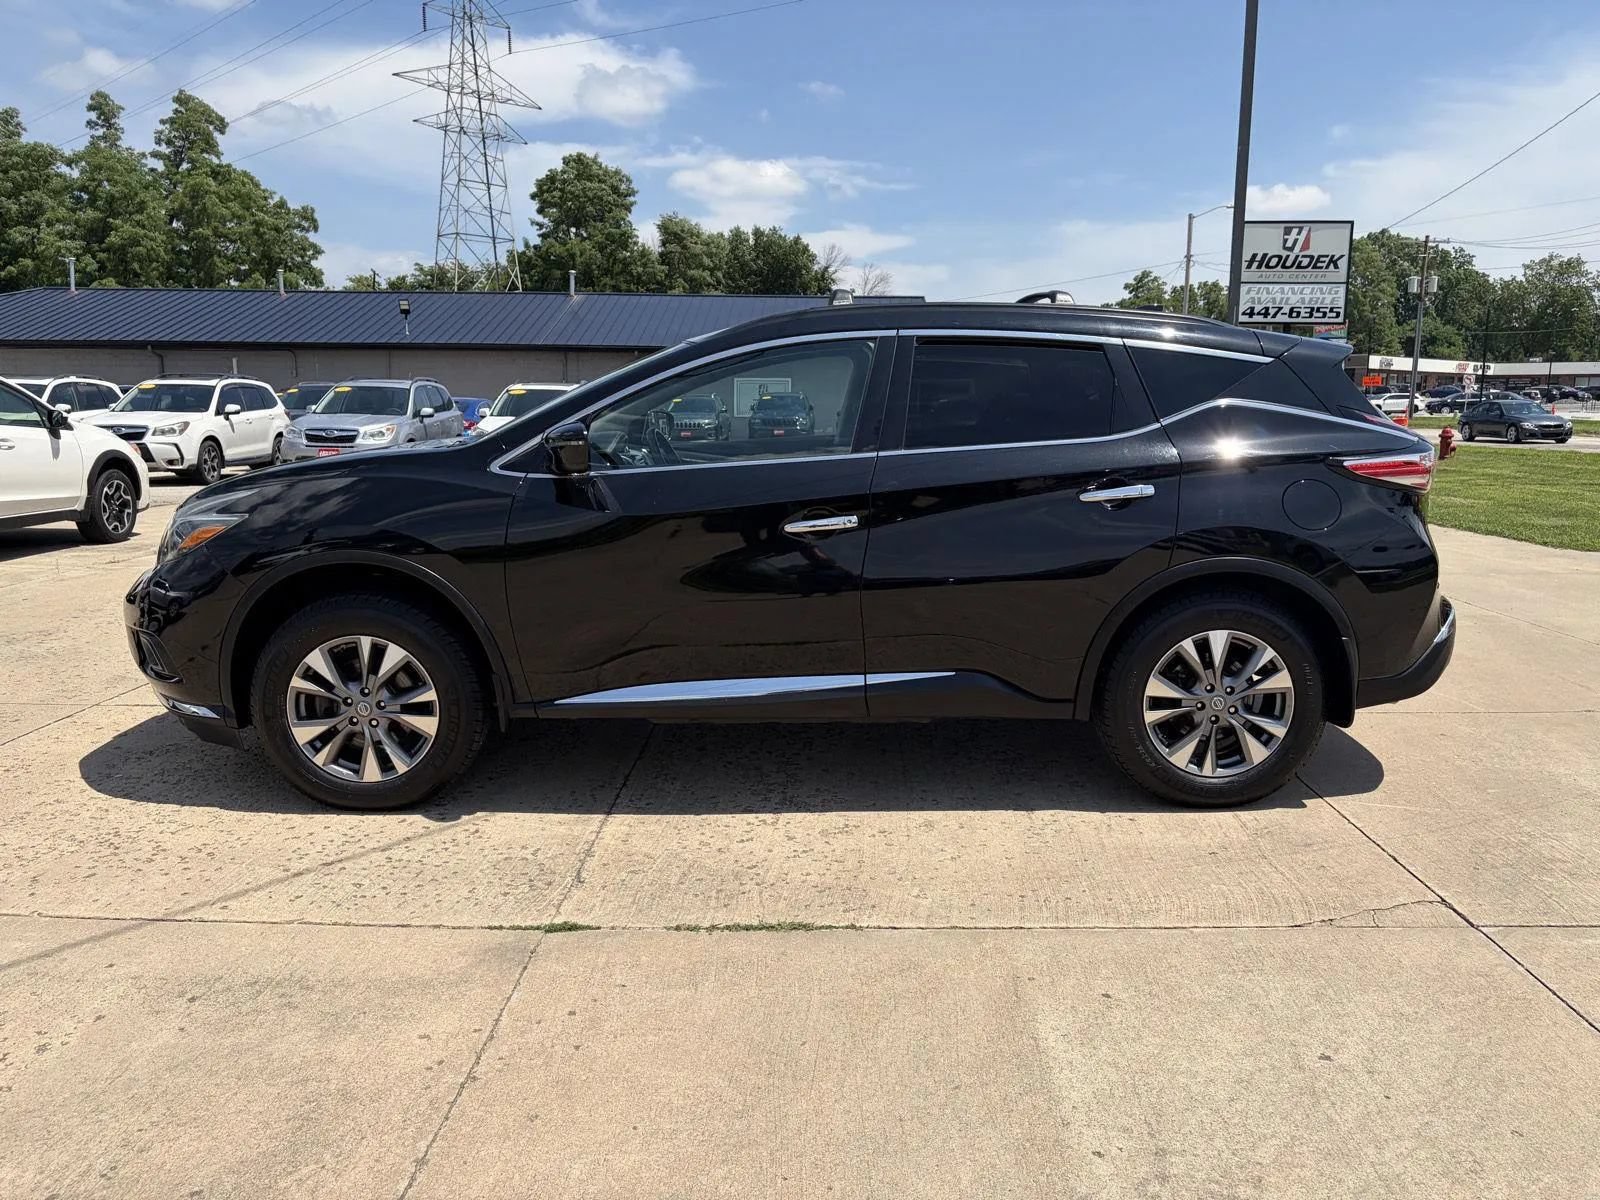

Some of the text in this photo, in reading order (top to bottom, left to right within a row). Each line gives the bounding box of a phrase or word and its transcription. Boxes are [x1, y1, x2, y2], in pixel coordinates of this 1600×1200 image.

[1244, 252, 1345, 270] HOUDEK
[1245, 286, 1341, 295] FINANCING
[1243, 296, 1341, 305] AVAILABLE
[1241, 306, 1342, 319] 447-6355
